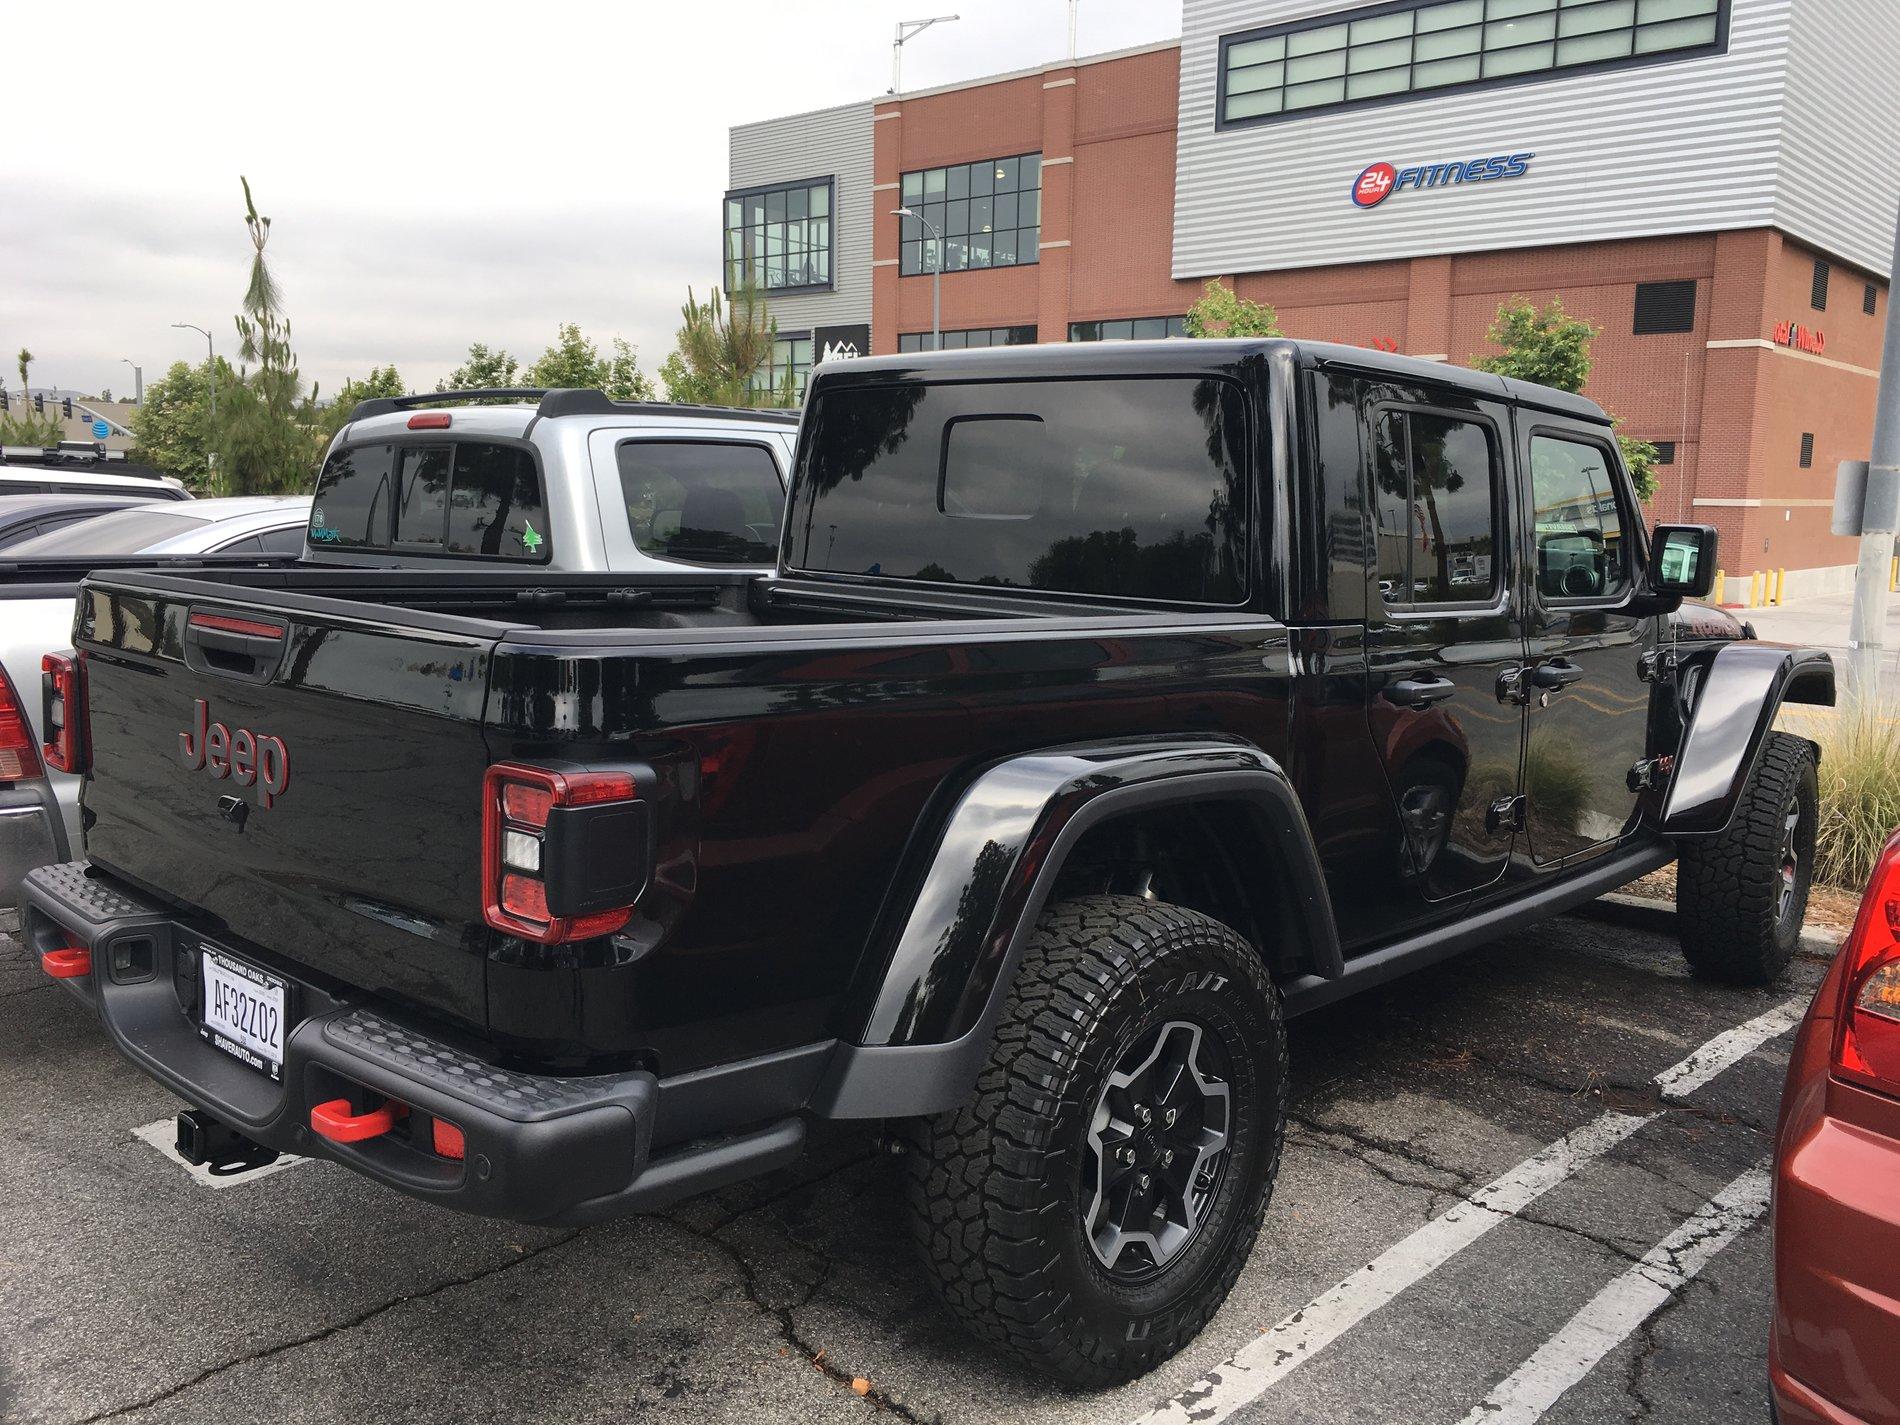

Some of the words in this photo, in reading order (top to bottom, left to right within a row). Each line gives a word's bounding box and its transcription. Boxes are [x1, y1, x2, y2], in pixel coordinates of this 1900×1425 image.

[1358, 187, 1380, 195] HOUR
[1360, 171, 1392, 192] 24
[1394, 153, 1532, 191] FITNESS
[179, 698, 290, 810] Jeep
[218, 955, 247, 977] THOUSAND
[247, 969, 264, 984] OAKS
[214, 979, 279, 1050] AF32Z02
[214, 1033, 263, 1070] SHAVERAUTO.com
